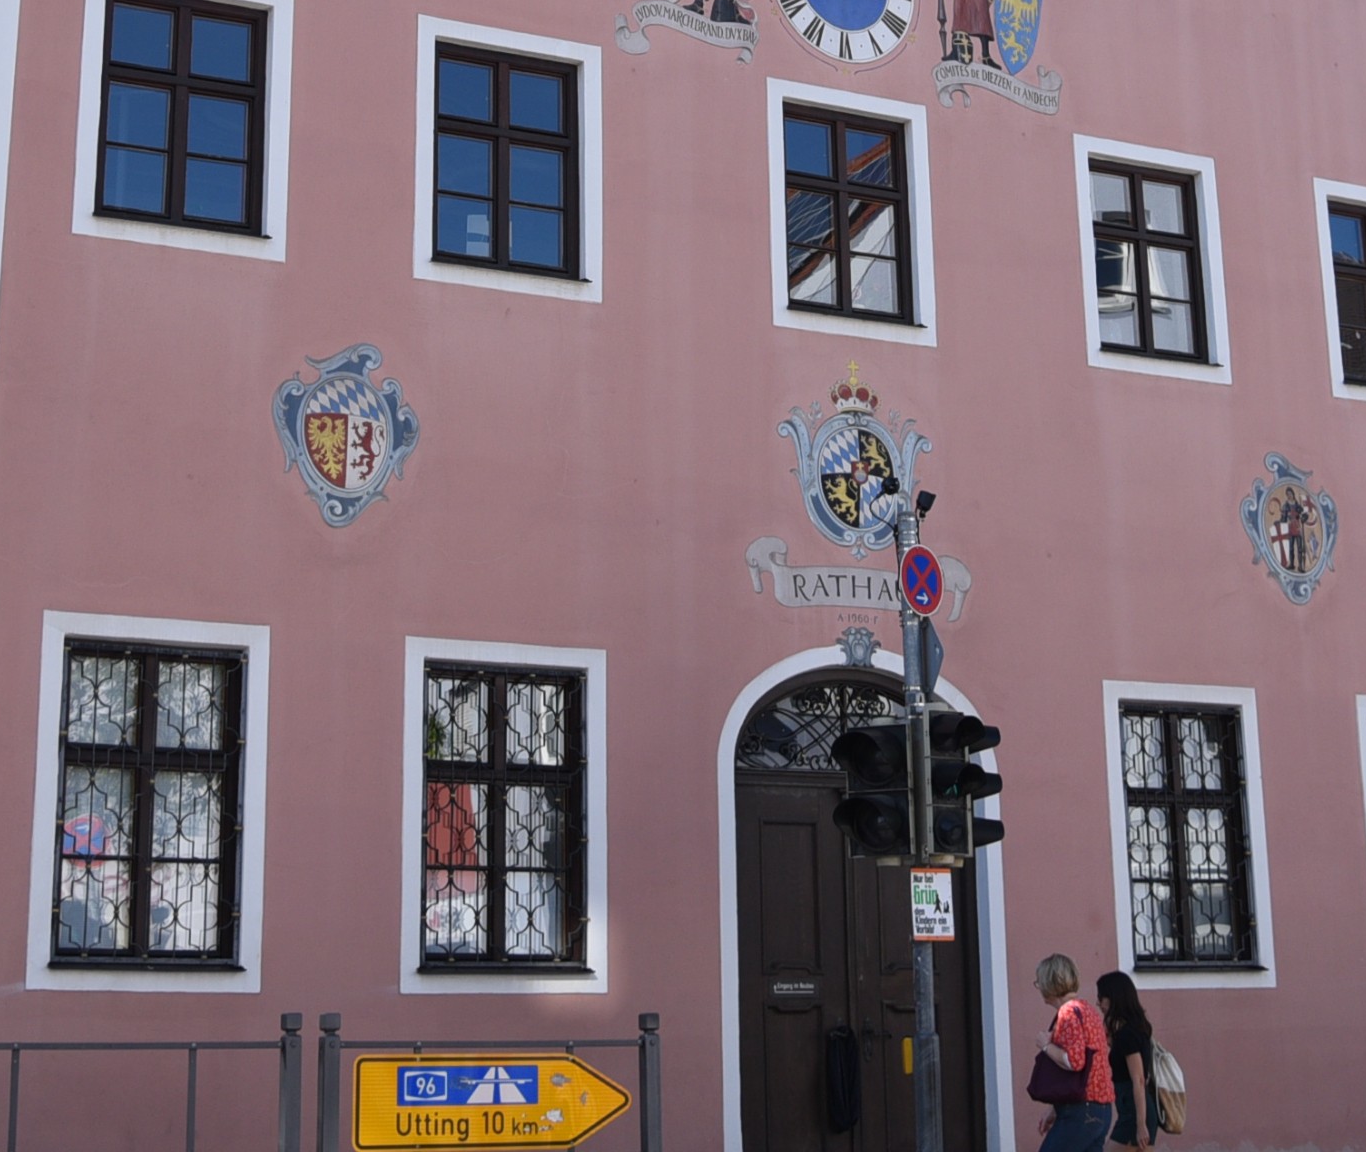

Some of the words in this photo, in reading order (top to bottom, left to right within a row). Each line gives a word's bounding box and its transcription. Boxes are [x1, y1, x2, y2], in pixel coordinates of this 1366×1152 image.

[935, 65, 970, 82] COMITES
[981, 69, 1012, 91] DIEZZEN
[1021, 88, 1058, 107] ANDECHS
[792, 573, 902, 602] RATHA
[416, 1077, 436, 1095] 96
[396, 1111, 470, 1142] Utting
[482, 1111, 505, 1135] 10
[512, 1118, 539, 1136] km
